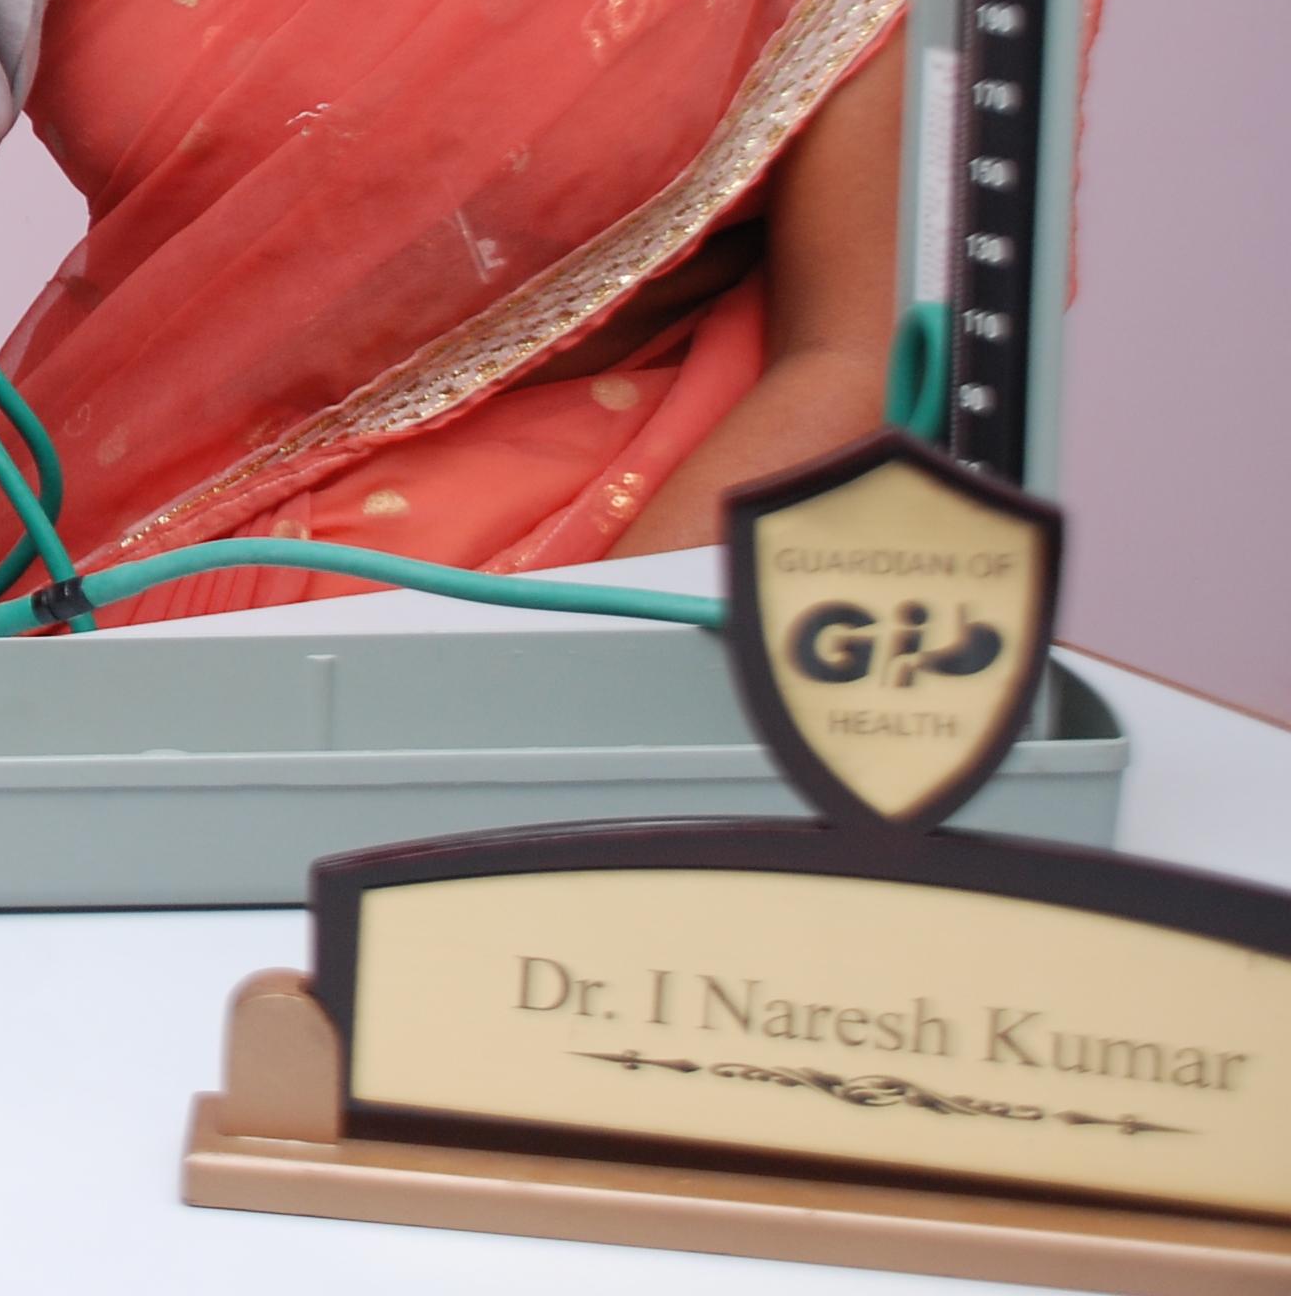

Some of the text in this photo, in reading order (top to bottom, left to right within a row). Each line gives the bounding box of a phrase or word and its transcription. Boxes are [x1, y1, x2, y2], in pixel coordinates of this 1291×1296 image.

[773, 546, 1016, 579] GUARDIAN OF
[826, 708, 960, 740] HEALTH
[511, 954, 1251, 1094] Dr. I Naresh Kumar
